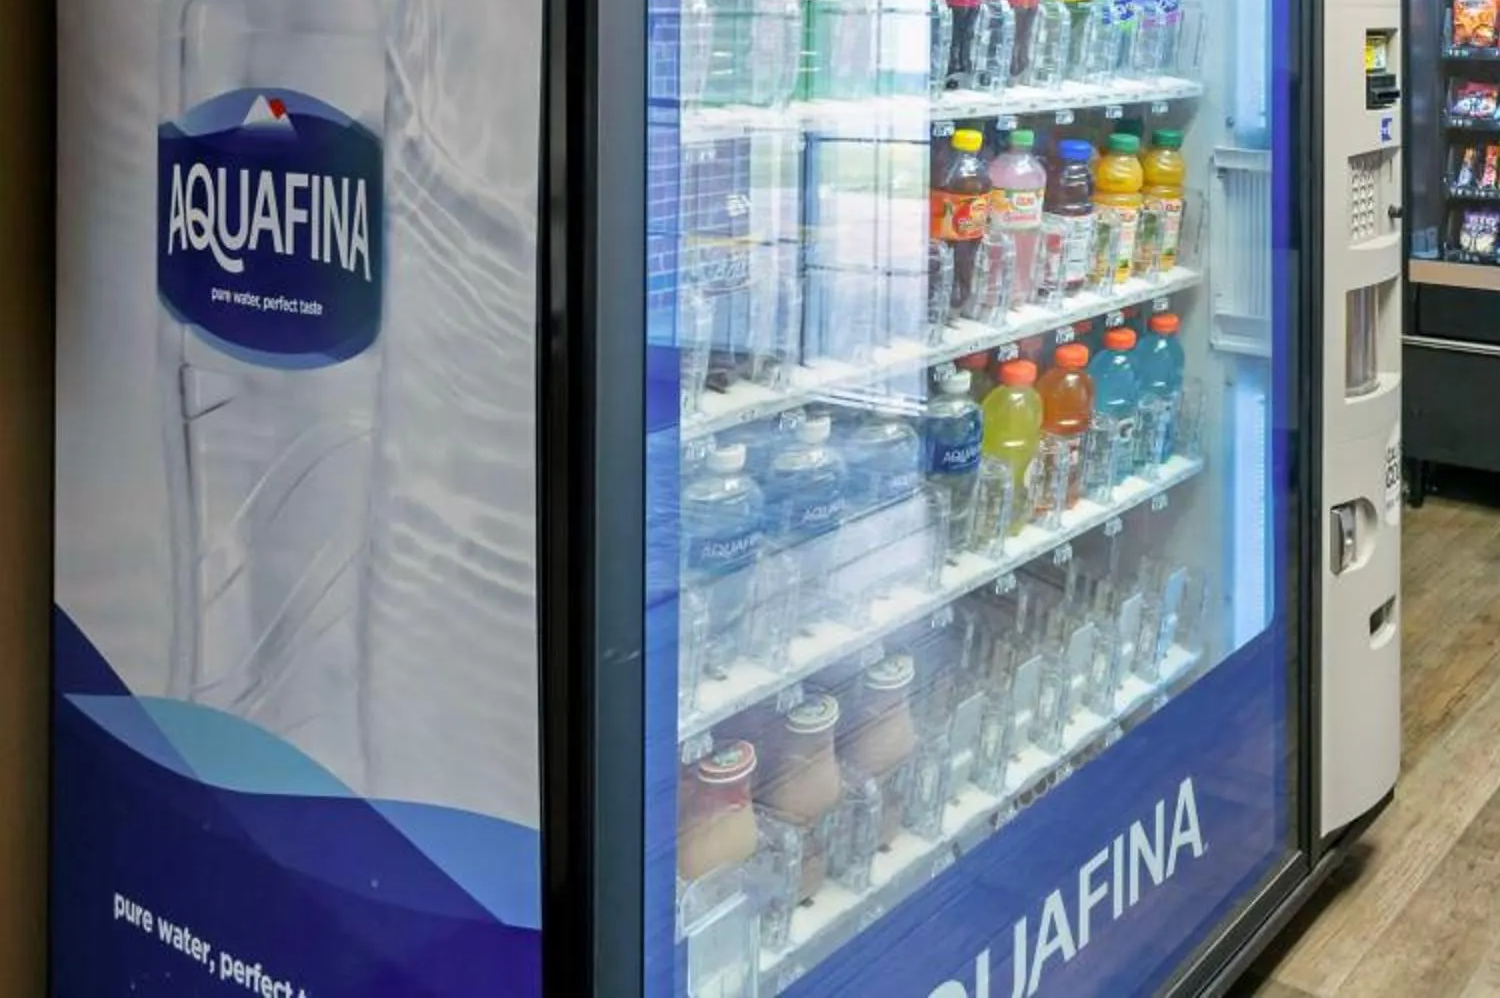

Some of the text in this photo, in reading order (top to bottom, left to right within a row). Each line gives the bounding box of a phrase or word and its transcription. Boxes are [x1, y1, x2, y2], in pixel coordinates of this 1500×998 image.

[168, 162, 372, 283] AQUAFINA
[211, 287, 232, 304] pure
[263, 295, 298, 313] perfect
[299, 299, 323, 315] taste
[113, 891, 153, 933] pure
[157, 916, 215, 974] water,
[926, 776, 1204, 998] UAFINA
